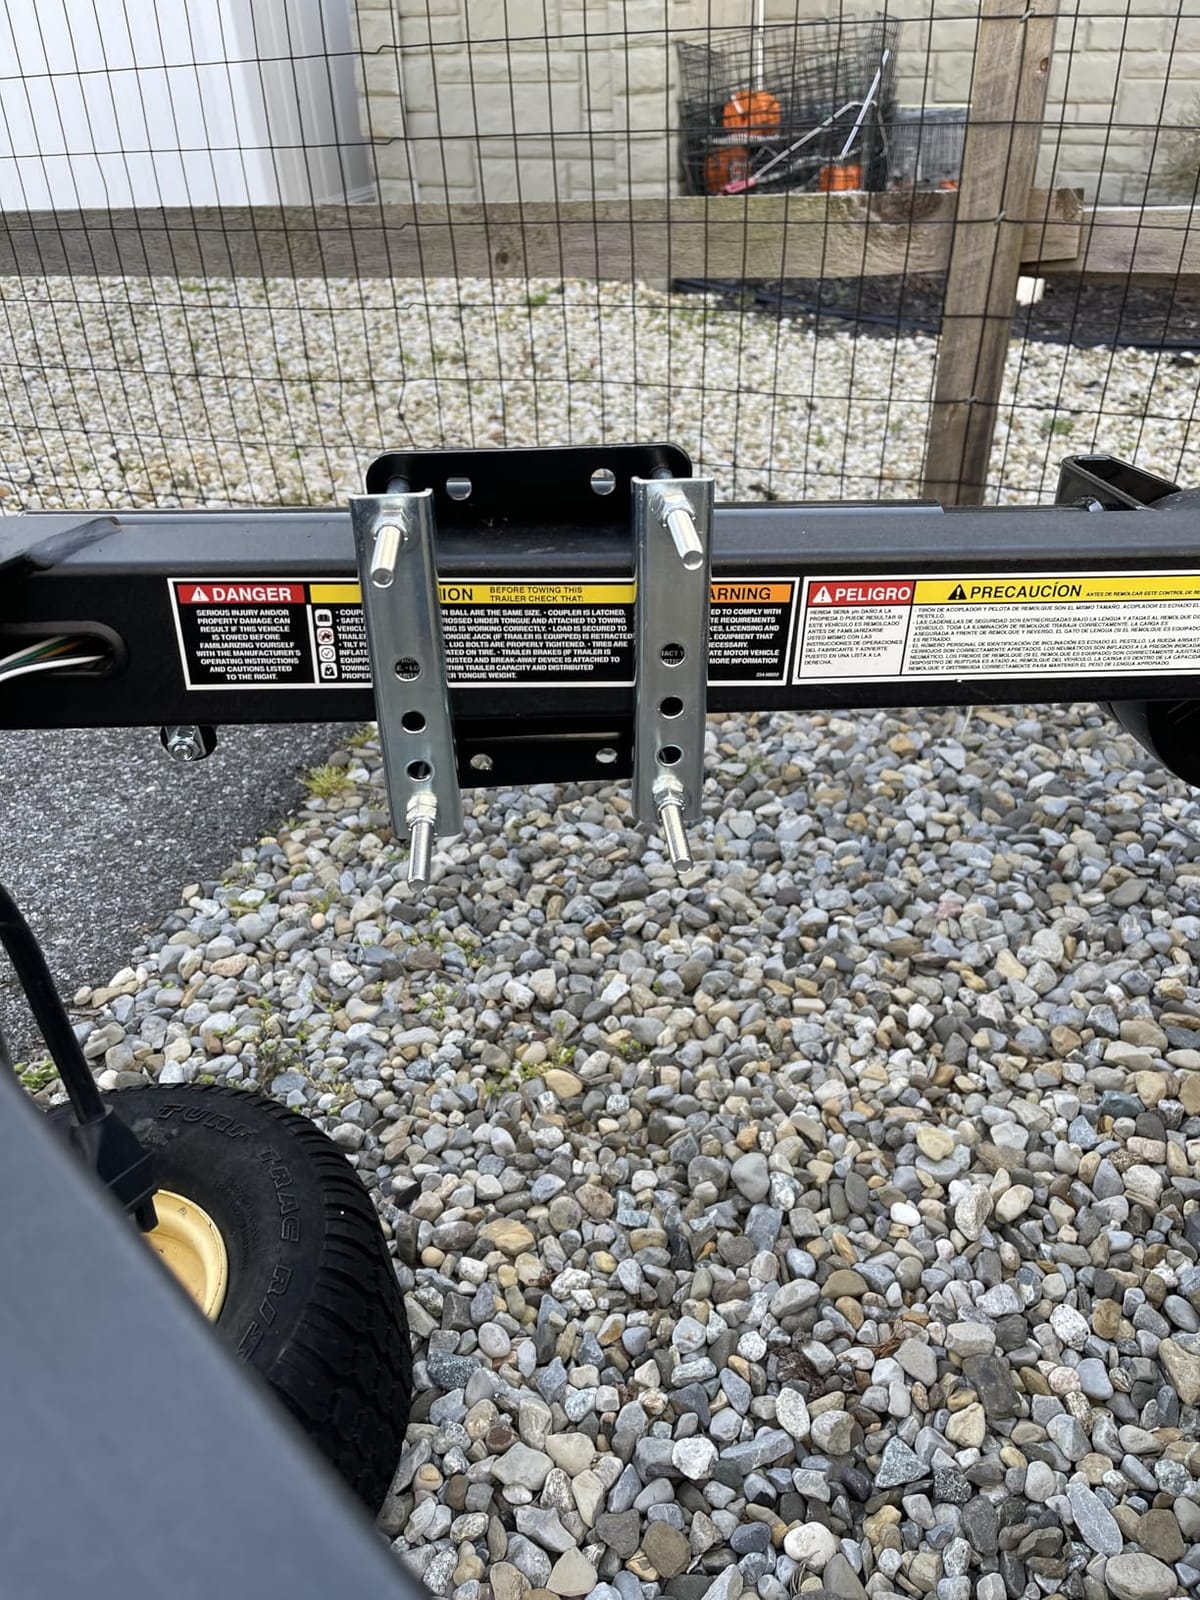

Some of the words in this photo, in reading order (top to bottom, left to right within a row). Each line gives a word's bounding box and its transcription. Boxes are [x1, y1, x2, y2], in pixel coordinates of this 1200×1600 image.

[212, 588, 291, 601] DANGER
[440, 588, 473, 600] ION
[835, 587, 910, 601] PELIGRO
[970, 582, 1082, 598] PRECAUCÍON
[158, 1104, 256, 1139] TURF
[257, 1145, 300, 1244] TRAC
